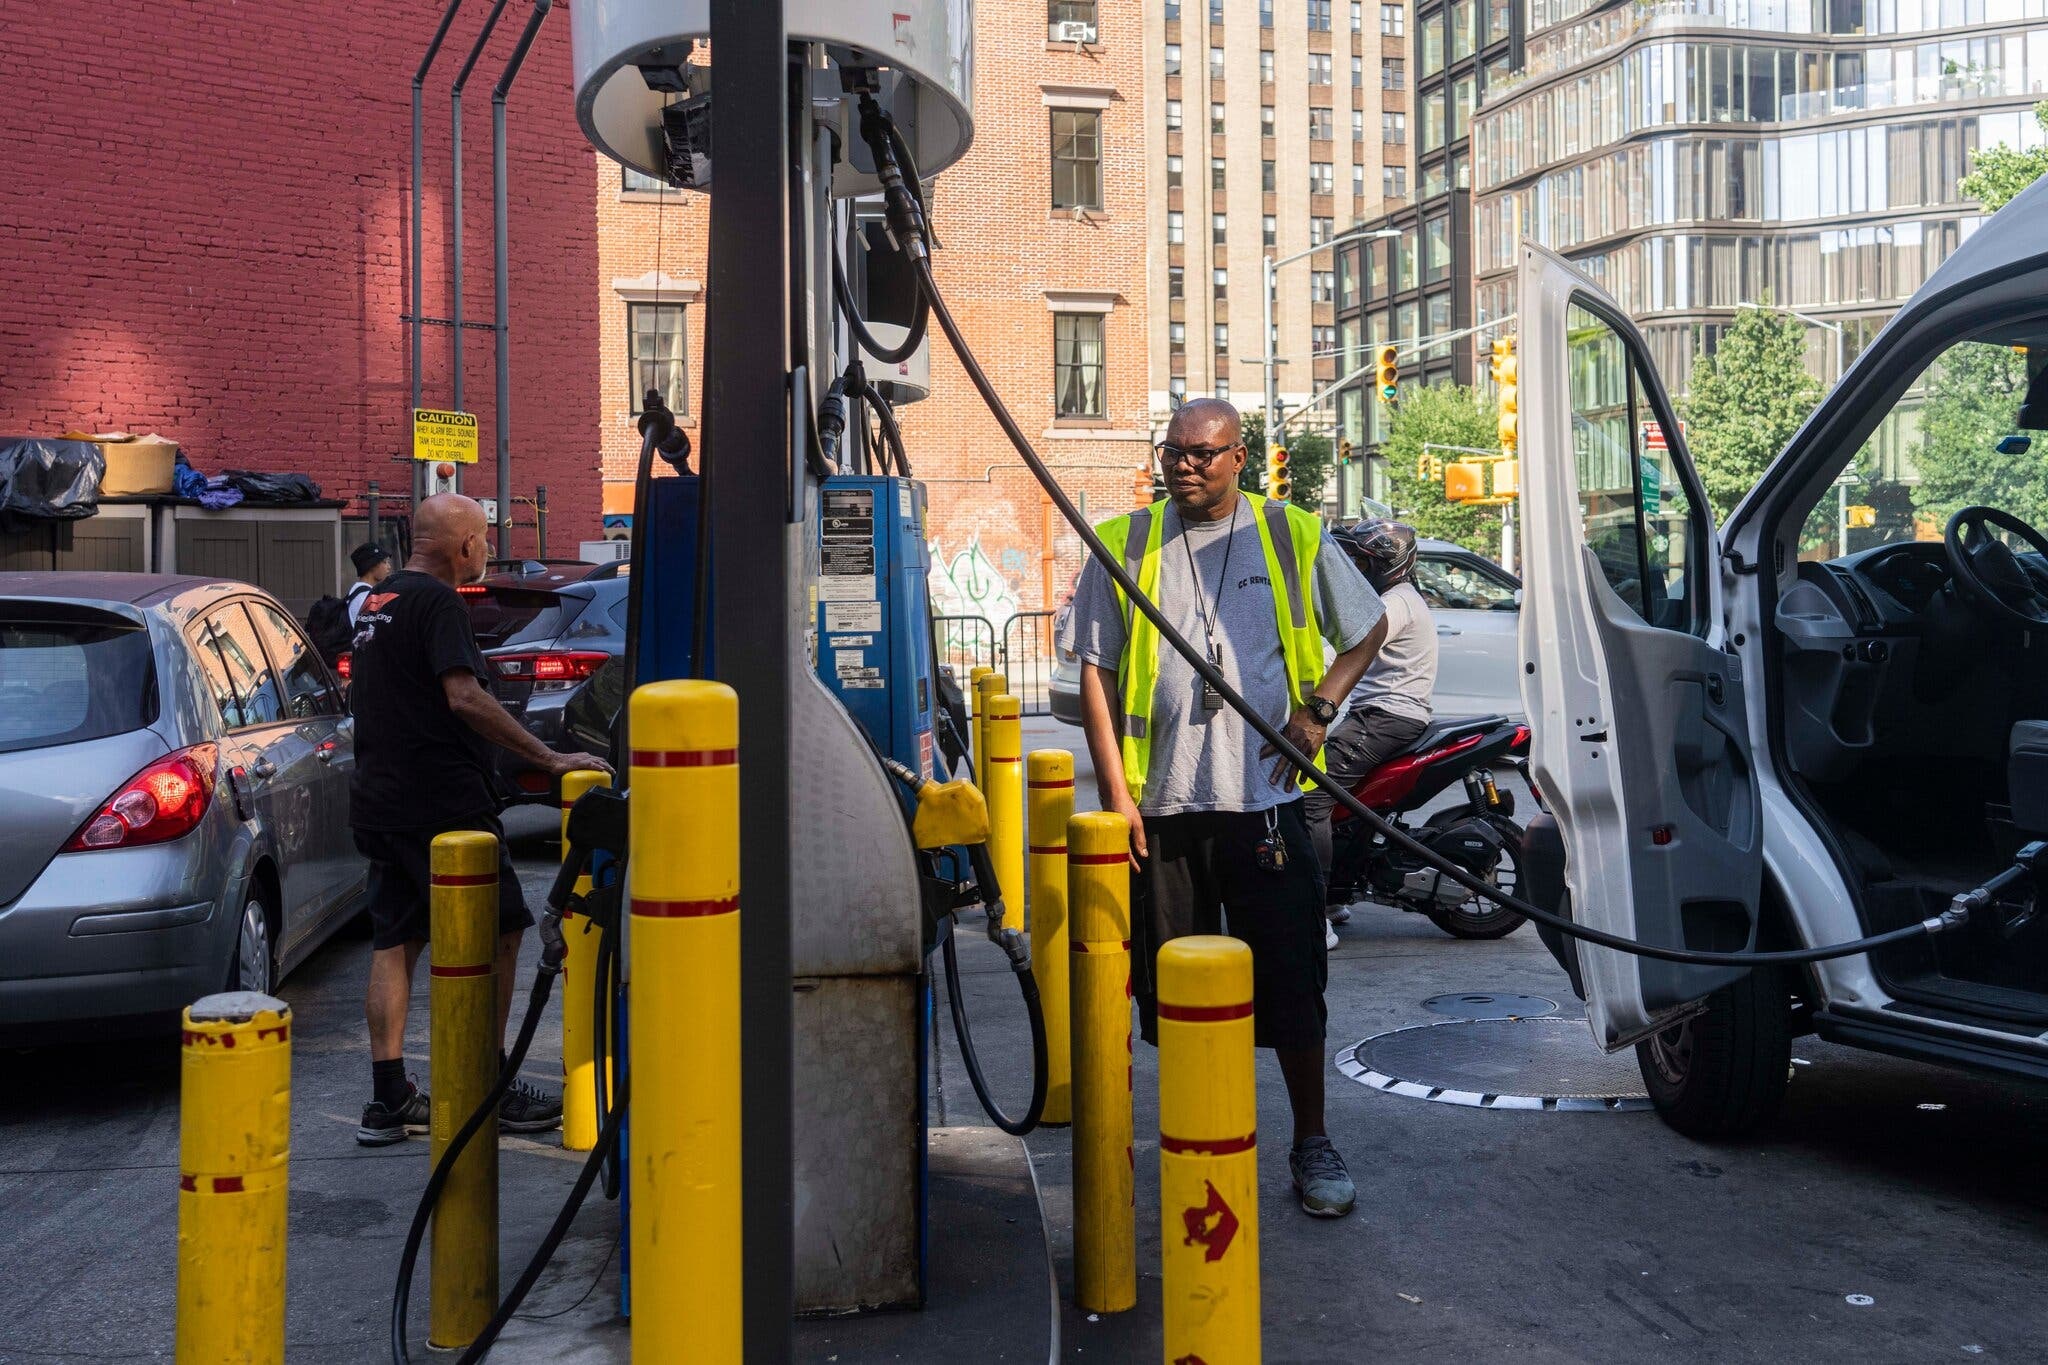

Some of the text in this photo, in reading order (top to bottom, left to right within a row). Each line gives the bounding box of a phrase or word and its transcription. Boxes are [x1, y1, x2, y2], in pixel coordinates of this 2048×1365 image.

[419, 413, 473, 425] CAUTION
[446, 427, 456, 436] BELL
[1238, 579, 1247, 589] CC
